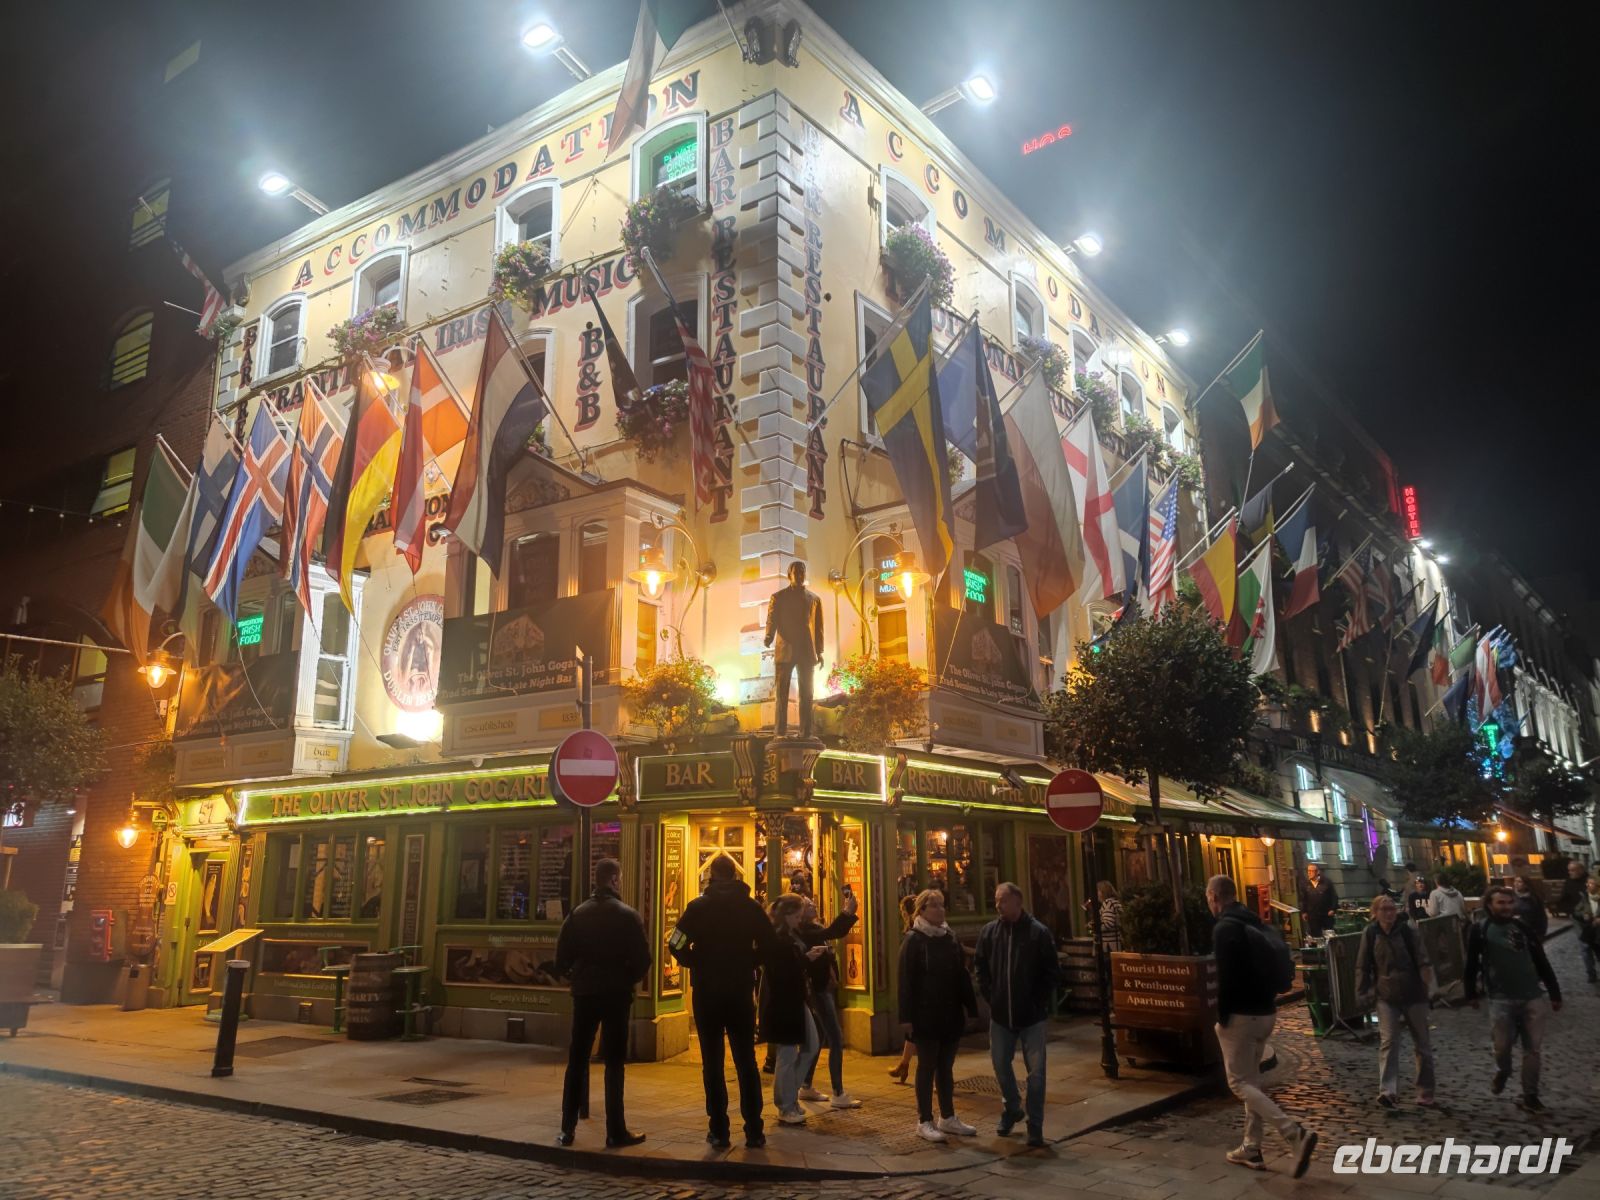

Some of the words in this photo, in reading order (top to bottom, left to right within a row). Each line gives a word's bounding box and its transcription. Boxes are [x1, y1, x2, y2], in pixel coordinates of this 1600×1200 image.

[710, 117, 737, 211] BAR
[292, 68, 701, 292] ACCOMMODATIN
[529, 254, 636, 321] MUSIC
[574, 327, 605, 433] B&B
[804, 218, 828, 521] RESTAURANT
[1404, 487, 1420, 536] HOSTEL
[966, 588, 985, 603] FOOD
[240, 633, 261, 645] FOOD
[242, 624, 261, 636] IRISH
[458, 671, 474, 684] The
[505, 666, 519, 678] St.
[521, 662, 546, 676] John
[530, 676, 555, 690] Night
[556, 674, 572, 685] Bar
[665, 761, 715, 787] BAR
[762, 771, 777, 787] 58
[832, 761, 867, 787] BAR
[907, 767, 989, 801] RESTAURANT
[271, 793, 301, 817] THE
[309, 788, 369, 815] OLIVER
[403, 782, 453, 808] JOHN
[464, 774, 549, 804] GOGART
[1120, 963, 1156, 974] Tourist
[1158, 965, 1190, 975] Hostel
[1124, 979, 1131, 988] &
[1134, 979, 1186, 992] Penthouse
[1127, 994, 1185, 1008] Apartments
